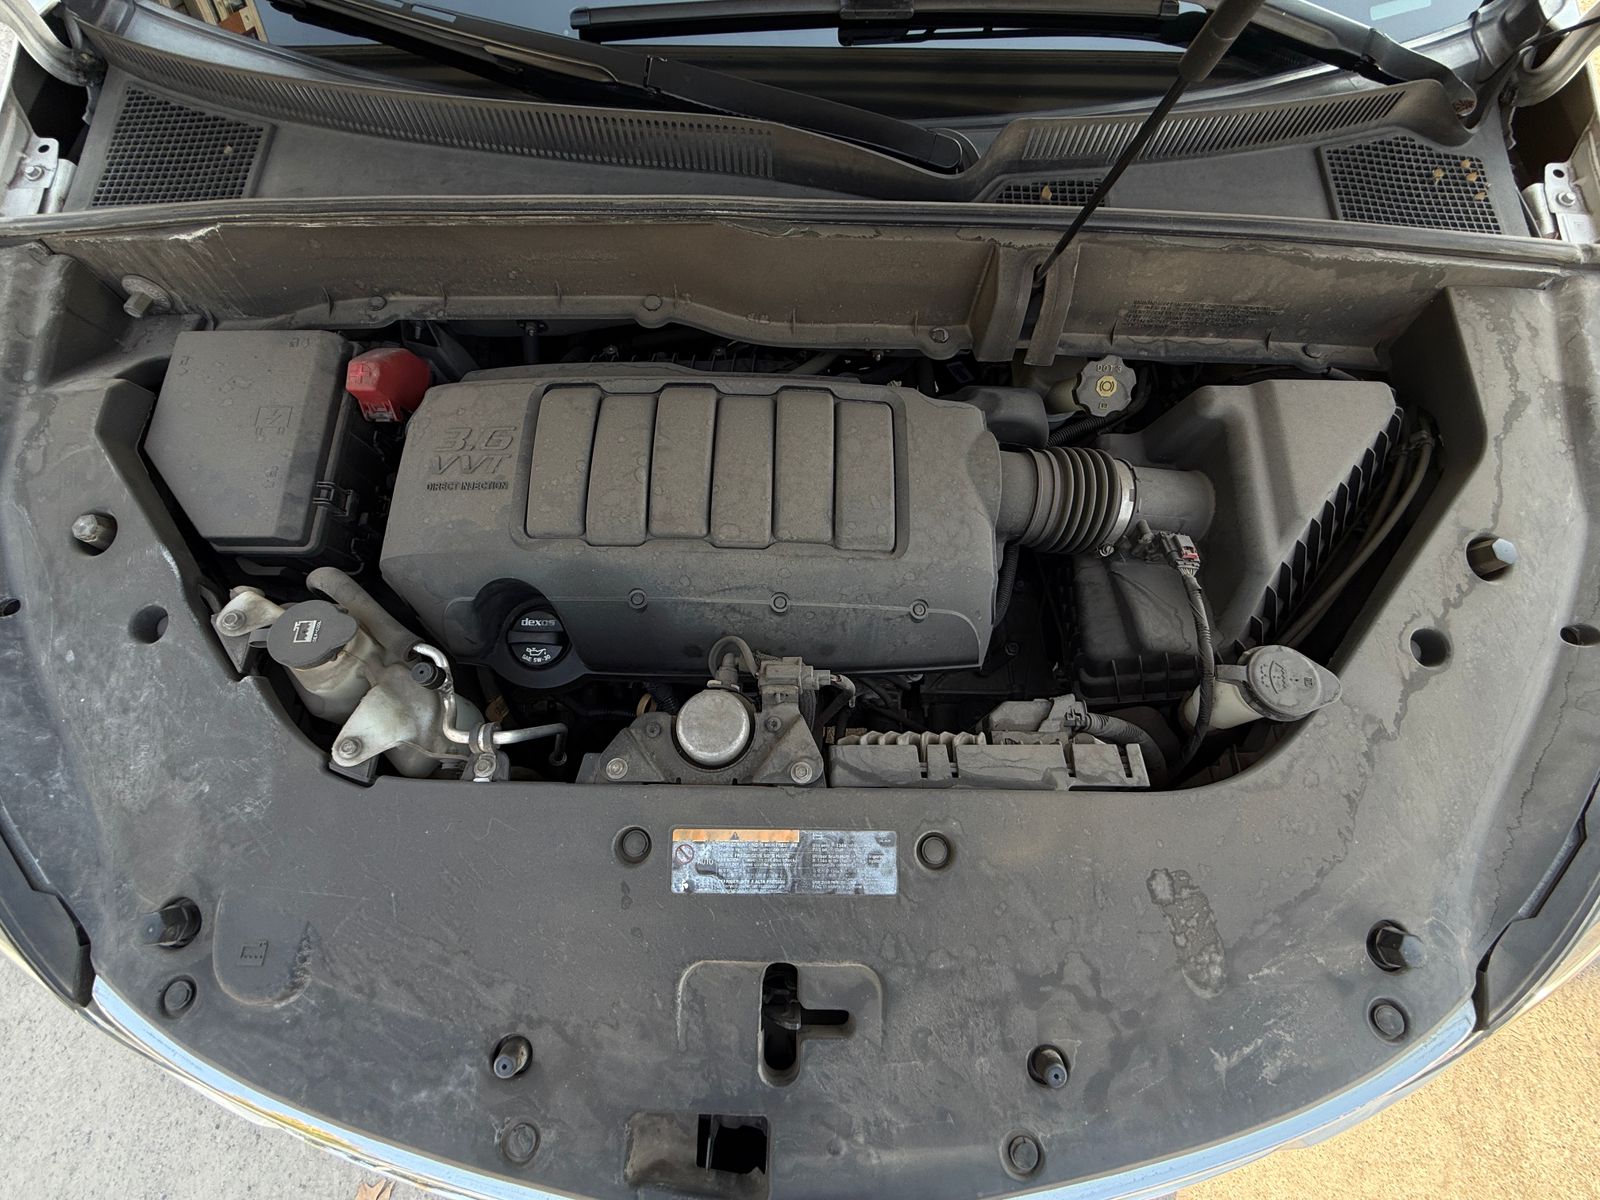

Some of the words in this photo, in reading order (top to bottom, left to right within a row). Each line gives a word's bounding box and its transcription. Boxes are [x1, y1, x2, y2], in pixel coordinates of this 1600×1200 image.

[434, 426, 517, 452] 3.6
[431, 454, 513, 475] VVT
[426, 481, 459, 491] DIRECT
[461, 481, 509, 491] INJECTION
[520, 617, 556, 626] dexos
